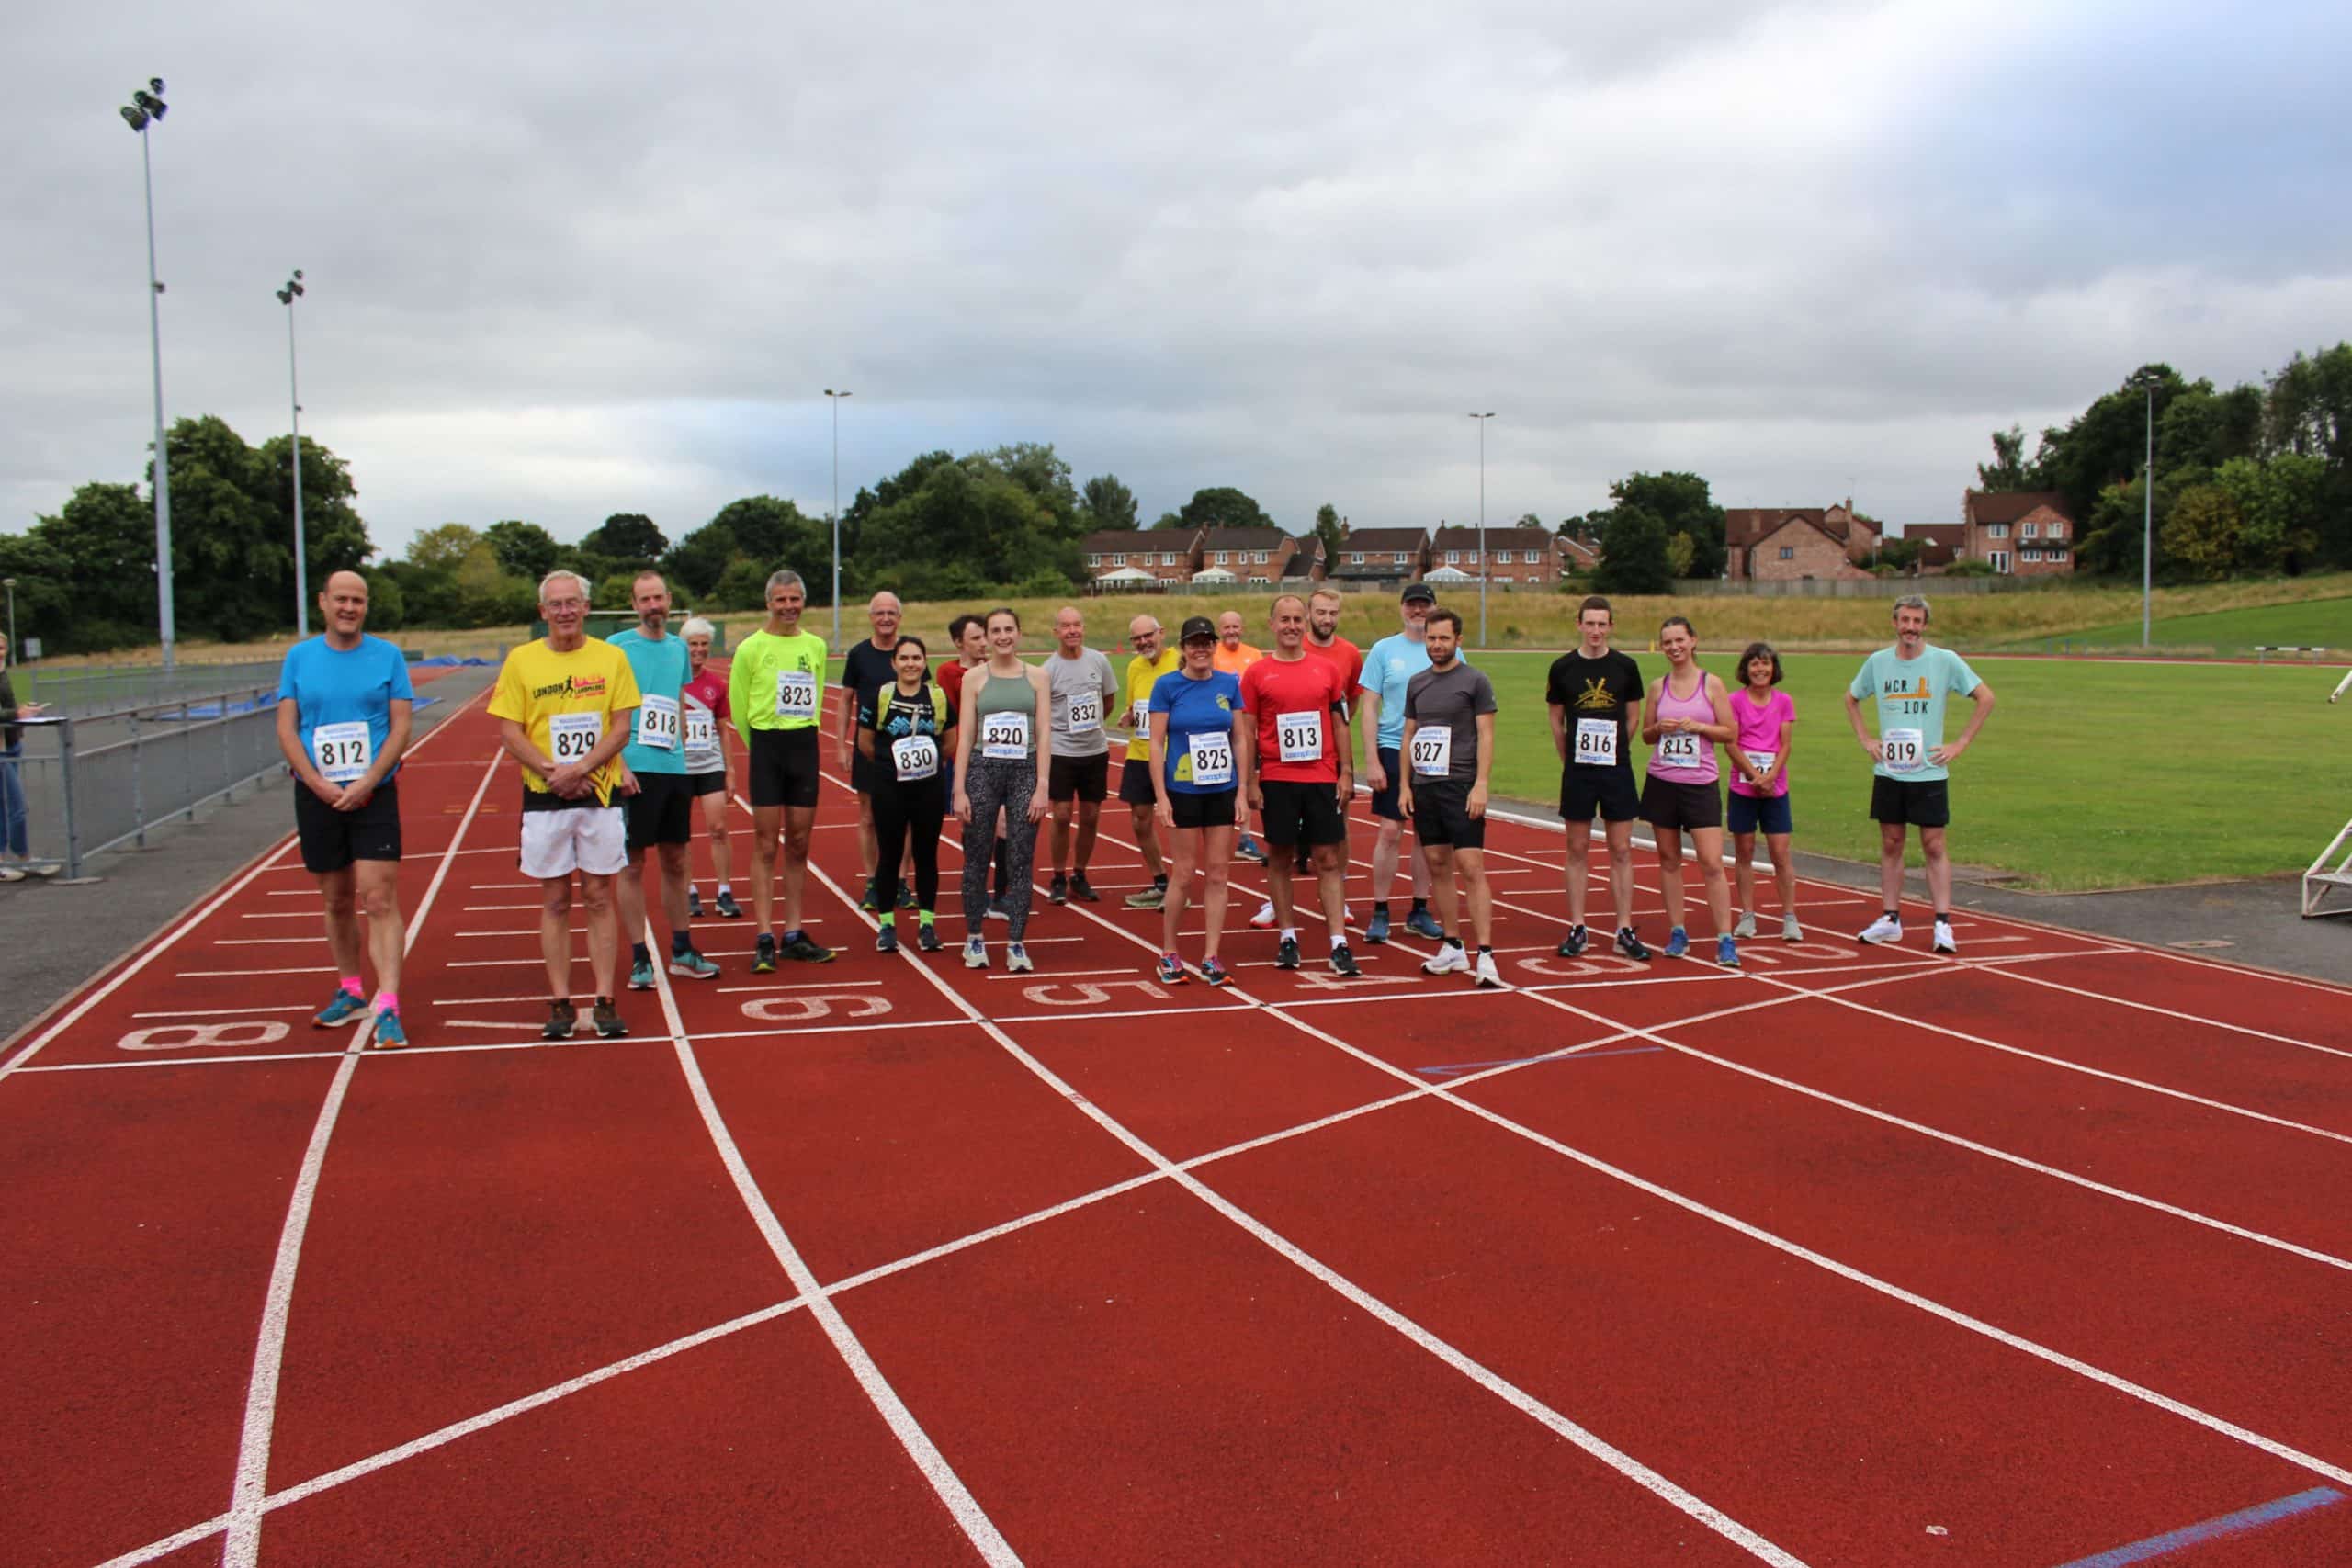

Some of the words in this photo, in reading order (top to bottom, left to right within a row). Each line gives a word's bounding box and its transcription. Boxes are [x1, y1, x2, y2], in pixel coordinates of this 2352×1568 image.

[533, 682, 564, 698] LONDON
[782, 685, 812, 706] 823
[1884, 680, 1907, 693] MCR
[1072, 705, 1096, 722] 832
[1905, 701, 1928, 714] 10K
[646, 711, 676, 735] 818
[1135, 712, 1150, 728] 81
[558, 731, 595, 756] 829
[989, 728, 1022, 745] 820
[1284, 728, 1317, 748] 813
[1580, 733, 1611, 753] 816
[1663, 738, 1693, 755] 815
[322, 740, 363, 765] 812
[900, 748, 932, 770] 830
[1197, 749, 1227, 770] 825
[1415, 742, 1442, 761] 827
[1887, 742, 1916, 761] 819
[1516, 955, 1651, 976] 3
[1295, 970, 1424, 990] 4
[1022, 980, 1174, 1006] 5
[741, 994, 893, 1021] 6
[116, 1020, 291, 1051] 8
